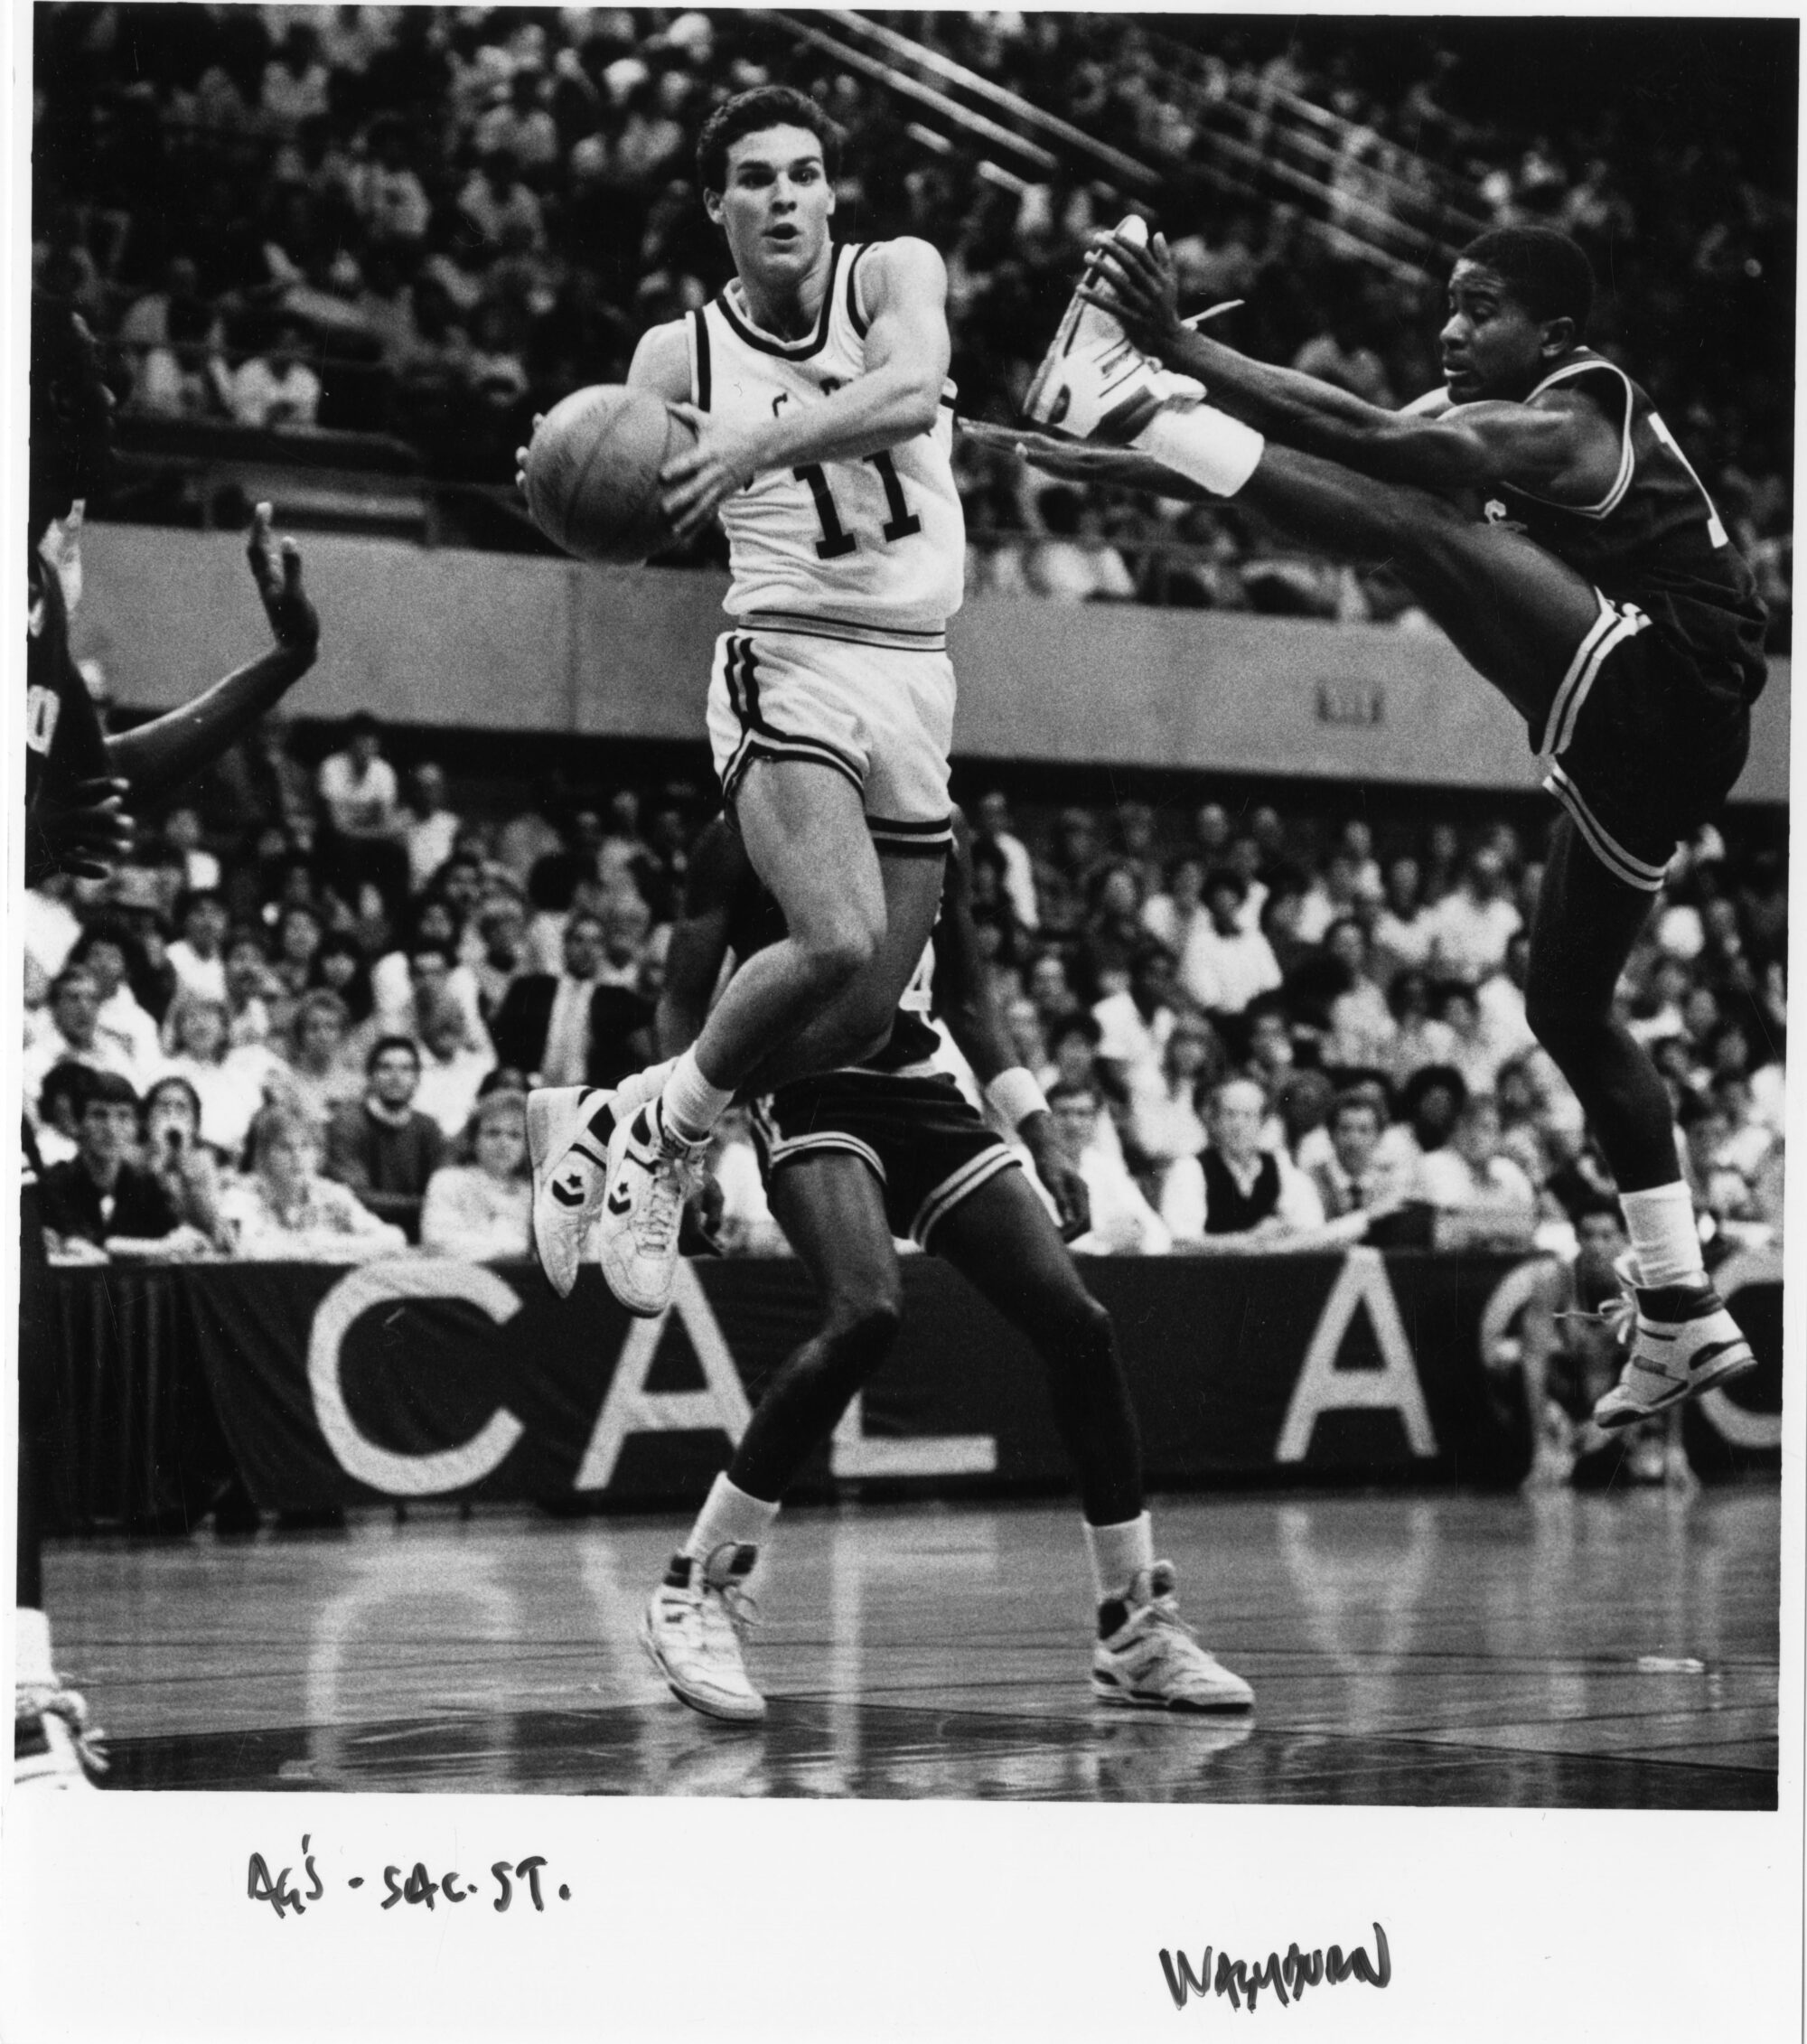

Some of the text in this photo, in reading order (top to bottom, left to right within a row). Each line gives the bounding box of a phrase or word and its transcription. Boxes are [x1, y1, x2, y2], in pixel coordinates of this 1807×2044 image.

[793, 450, 921, 559] 11
[307, 1256, 996, 1495] CAL
[491, 1855, 572, 1913] ST.
